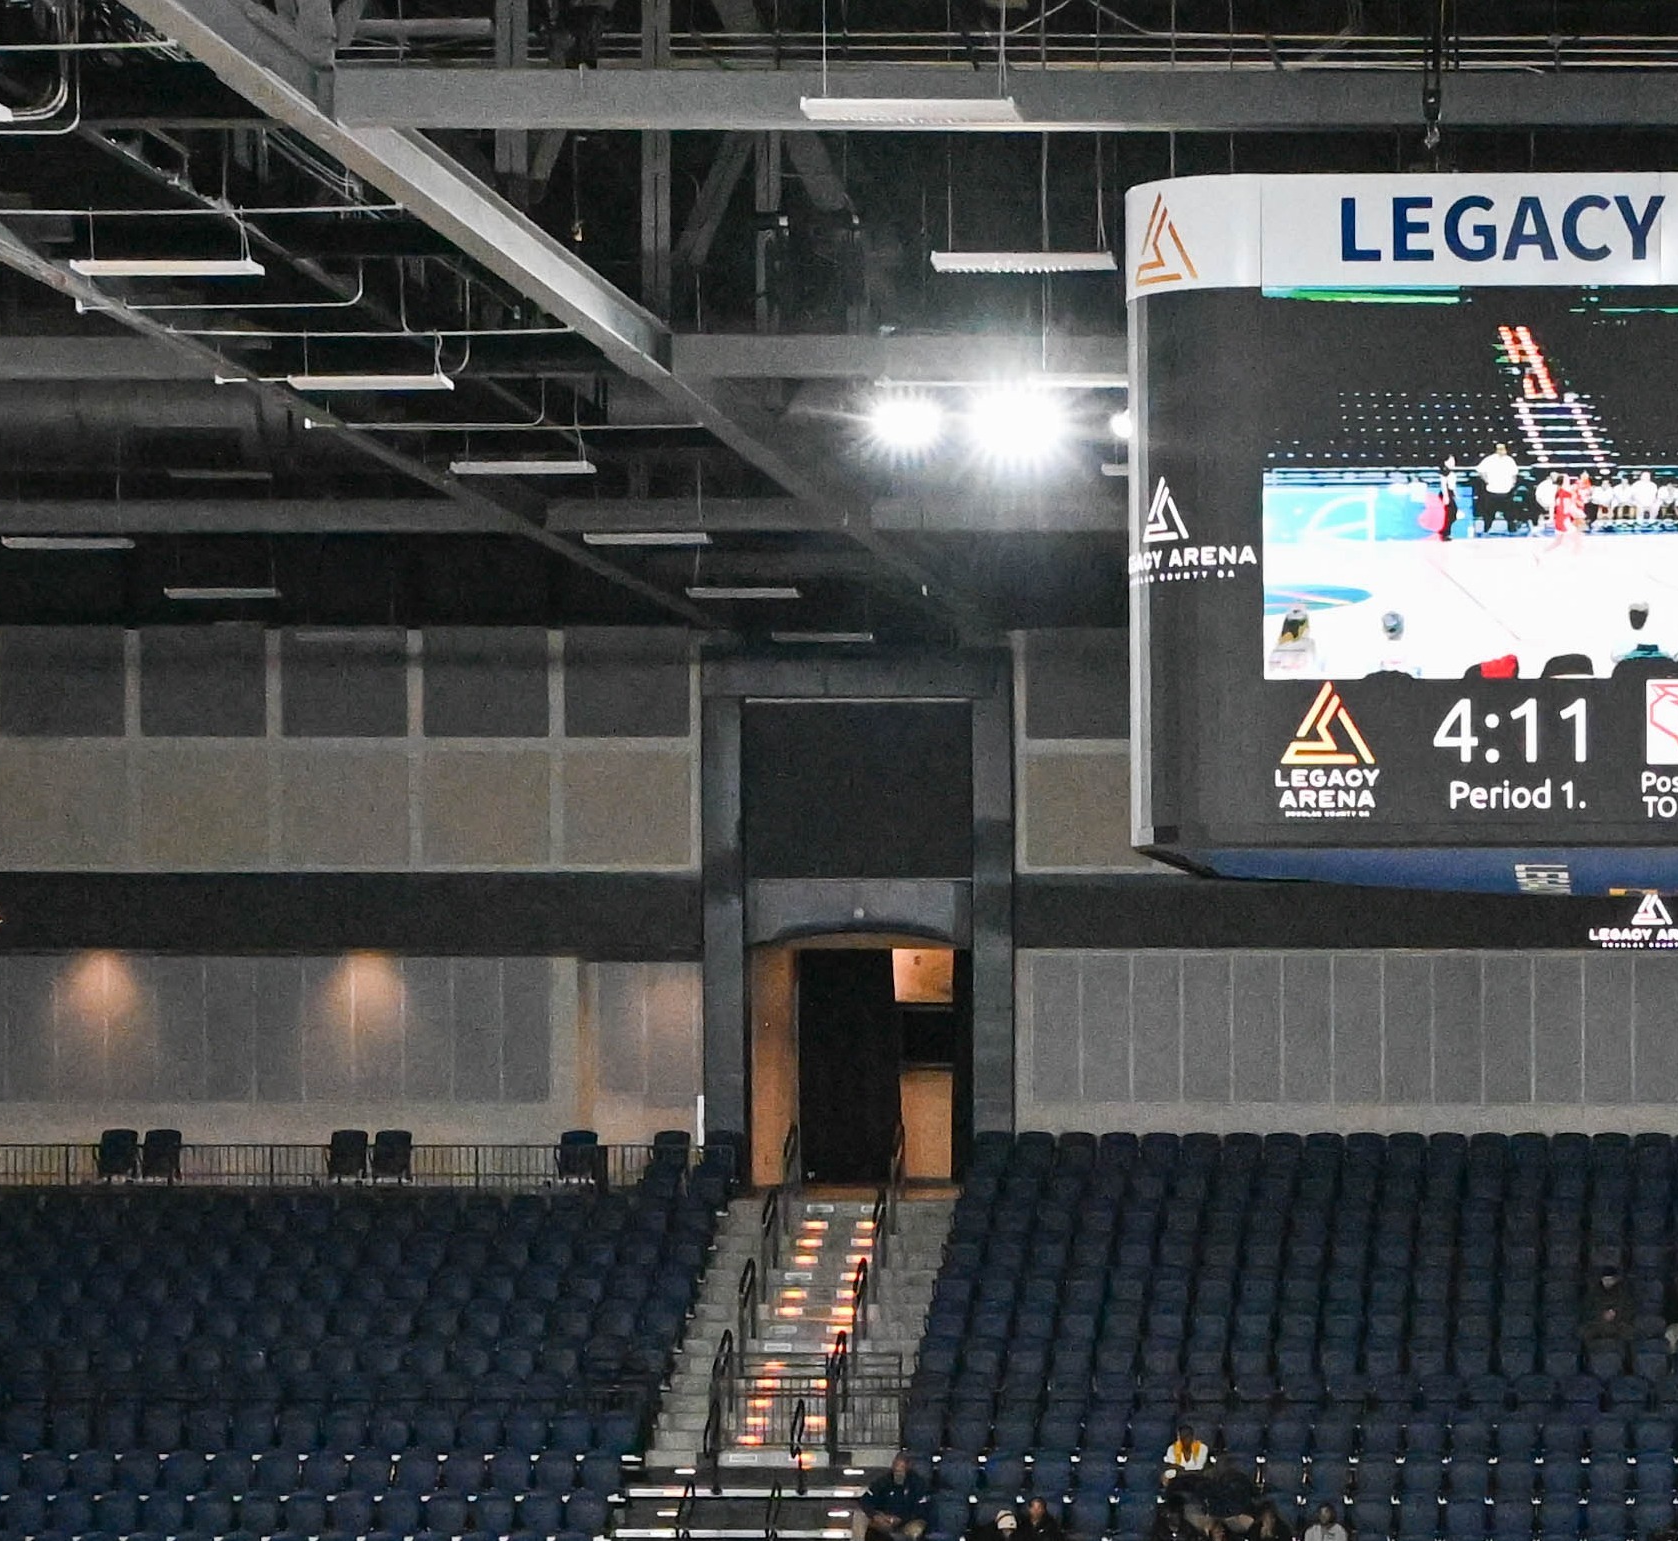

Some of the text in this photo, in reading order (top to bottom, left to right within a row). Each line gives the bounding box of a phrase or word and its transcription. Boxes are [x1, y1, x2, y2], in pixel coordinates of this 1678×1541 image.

[1340, 194, 1666, 262] LEGACY
[1168, 544, 1258, 568] ARENA
[1433, 698, 1587, 763] 4:11
[1274, 768, 1381, 788] LEGACY
[1278, 789, 1377, 808] ARENA
[1449, 778, 1587, 809] Period 1.
[1642, 796, 1678, 818] TO
[1588, 927, 1654, 942] LEGACY
